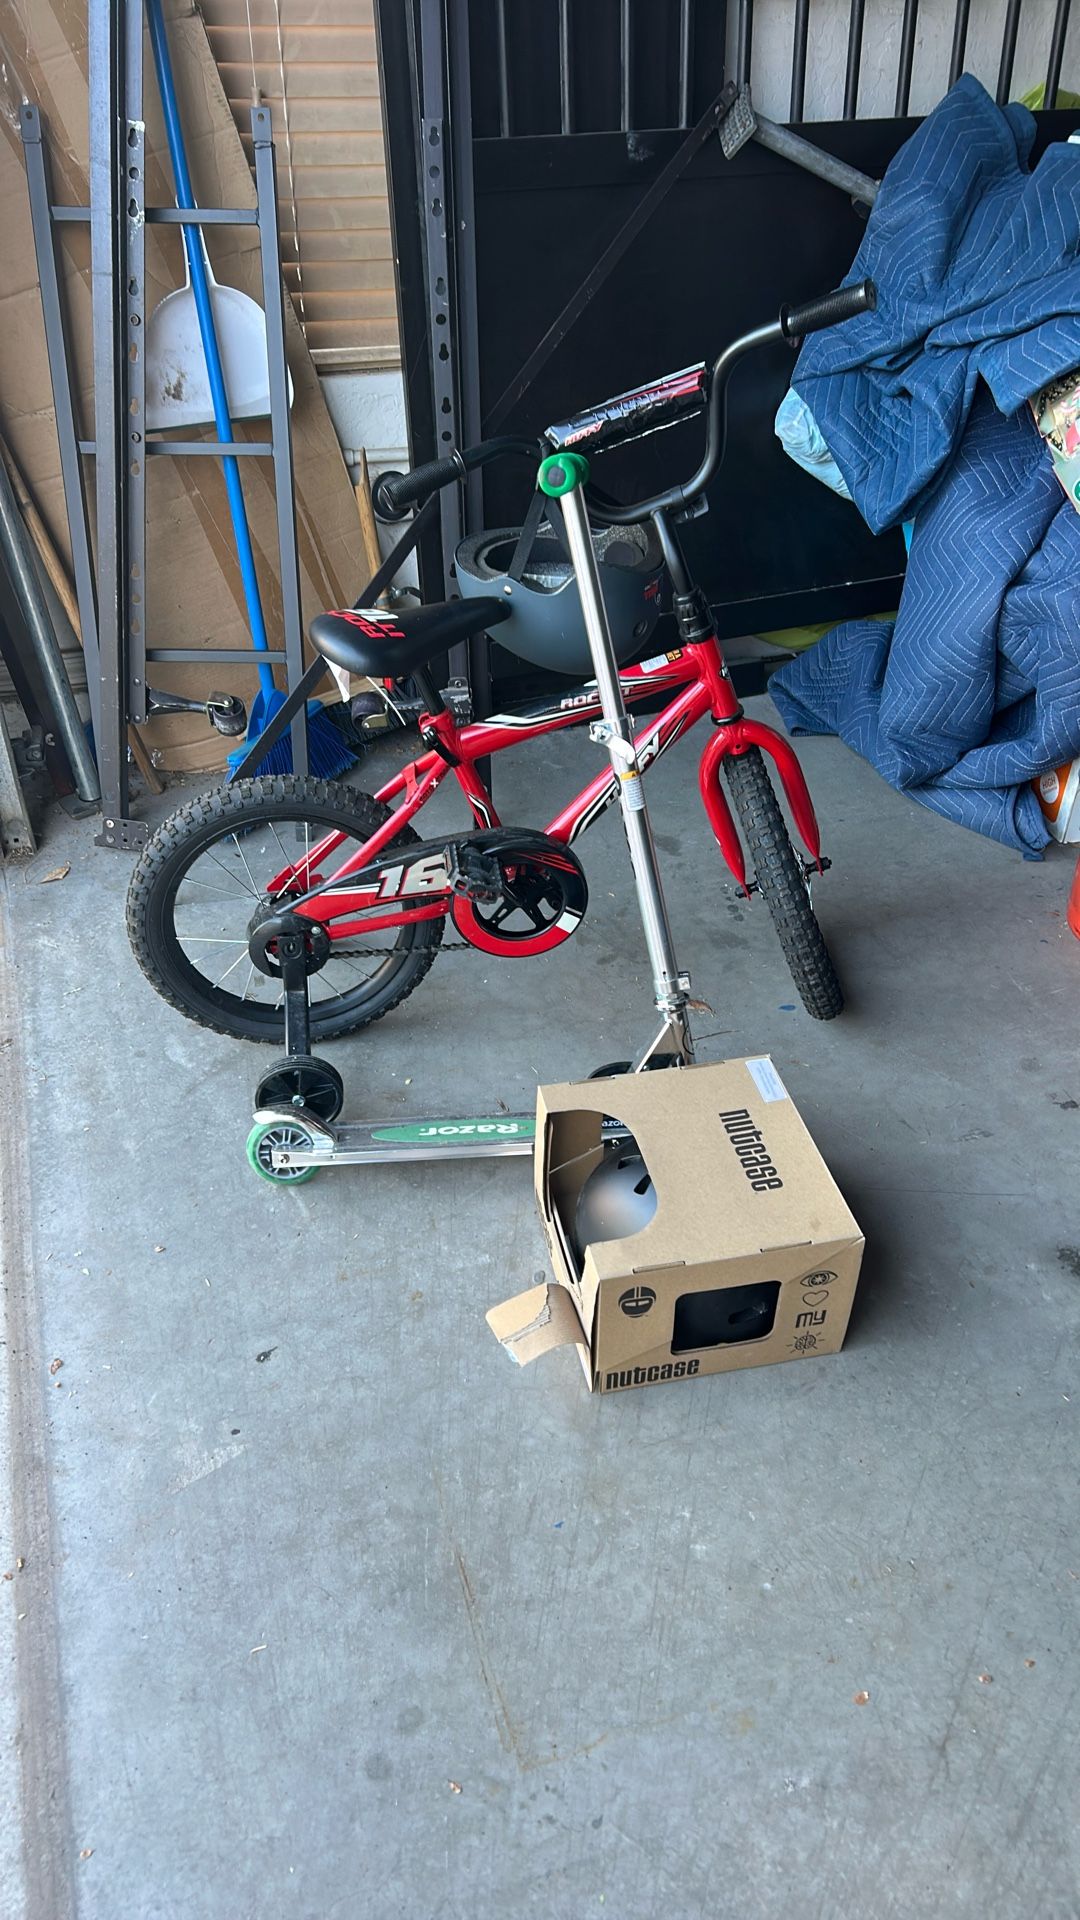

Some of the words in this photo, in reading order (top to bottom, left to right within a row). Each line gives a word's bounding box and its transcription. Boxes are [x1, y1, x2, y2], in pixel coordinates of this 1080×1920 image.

[560, 692, 600, 710] ROC
[378, 852, 450, 898] 16
[718, 1108, 784, 1192] nutcase
[606, 1359, 700, 1390] nutcase
